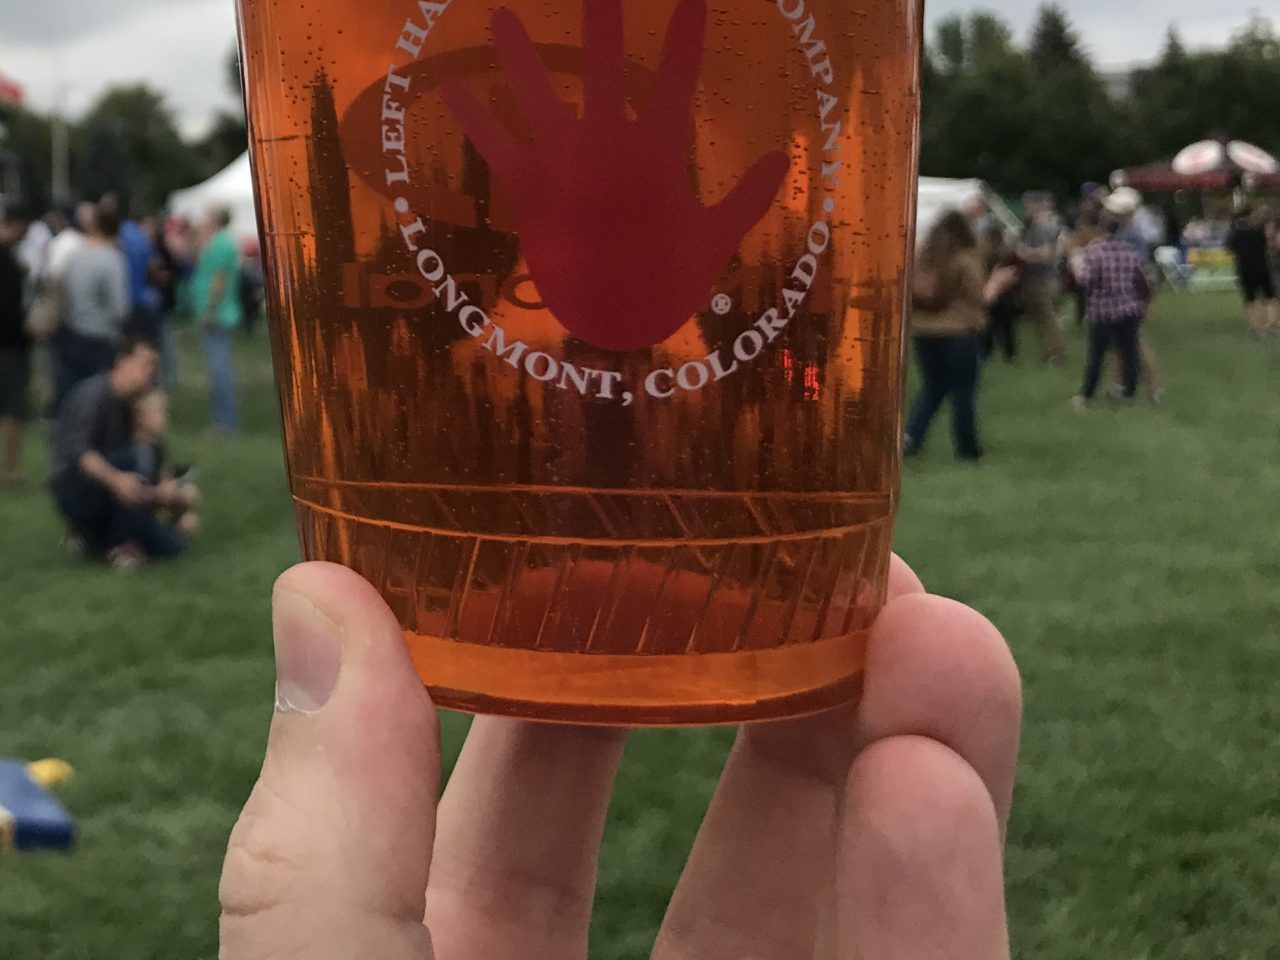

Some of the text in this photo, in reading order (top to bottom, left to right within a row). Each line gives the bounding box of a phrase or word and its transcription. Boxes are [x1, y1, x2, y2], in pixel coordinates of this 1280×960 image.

[381, 65, 412, 186] LEFT
[399, 216, 830, 406] LONGMONT, COLORADO
